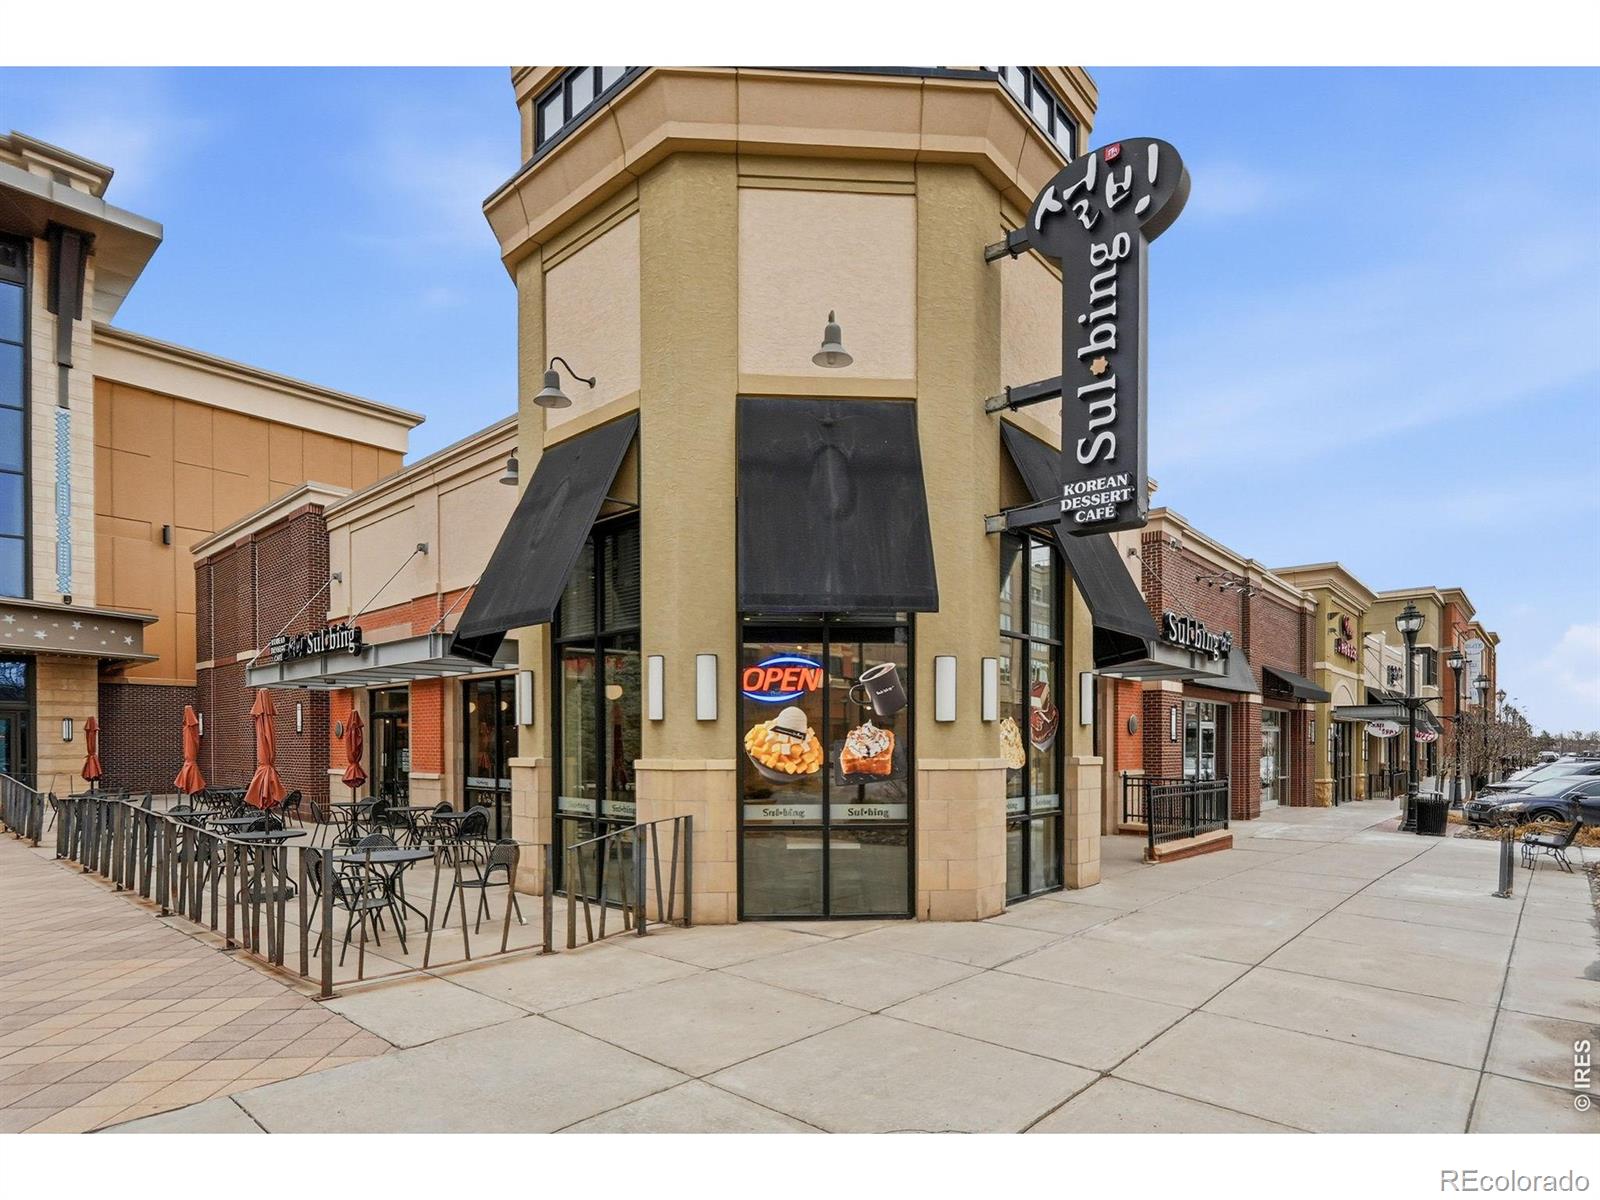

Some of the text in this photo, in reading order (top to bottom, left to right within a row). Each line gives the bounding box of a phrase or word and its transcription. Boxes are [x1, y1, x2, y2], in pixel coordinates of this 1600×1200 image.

[1063, 473, 1128, 496] KOREAN
[1060, 487, 1132, 511] DESSERT
[1075, 503, 1115, 522] CAFÉ
[743, 667, 821, 692] OPEN
